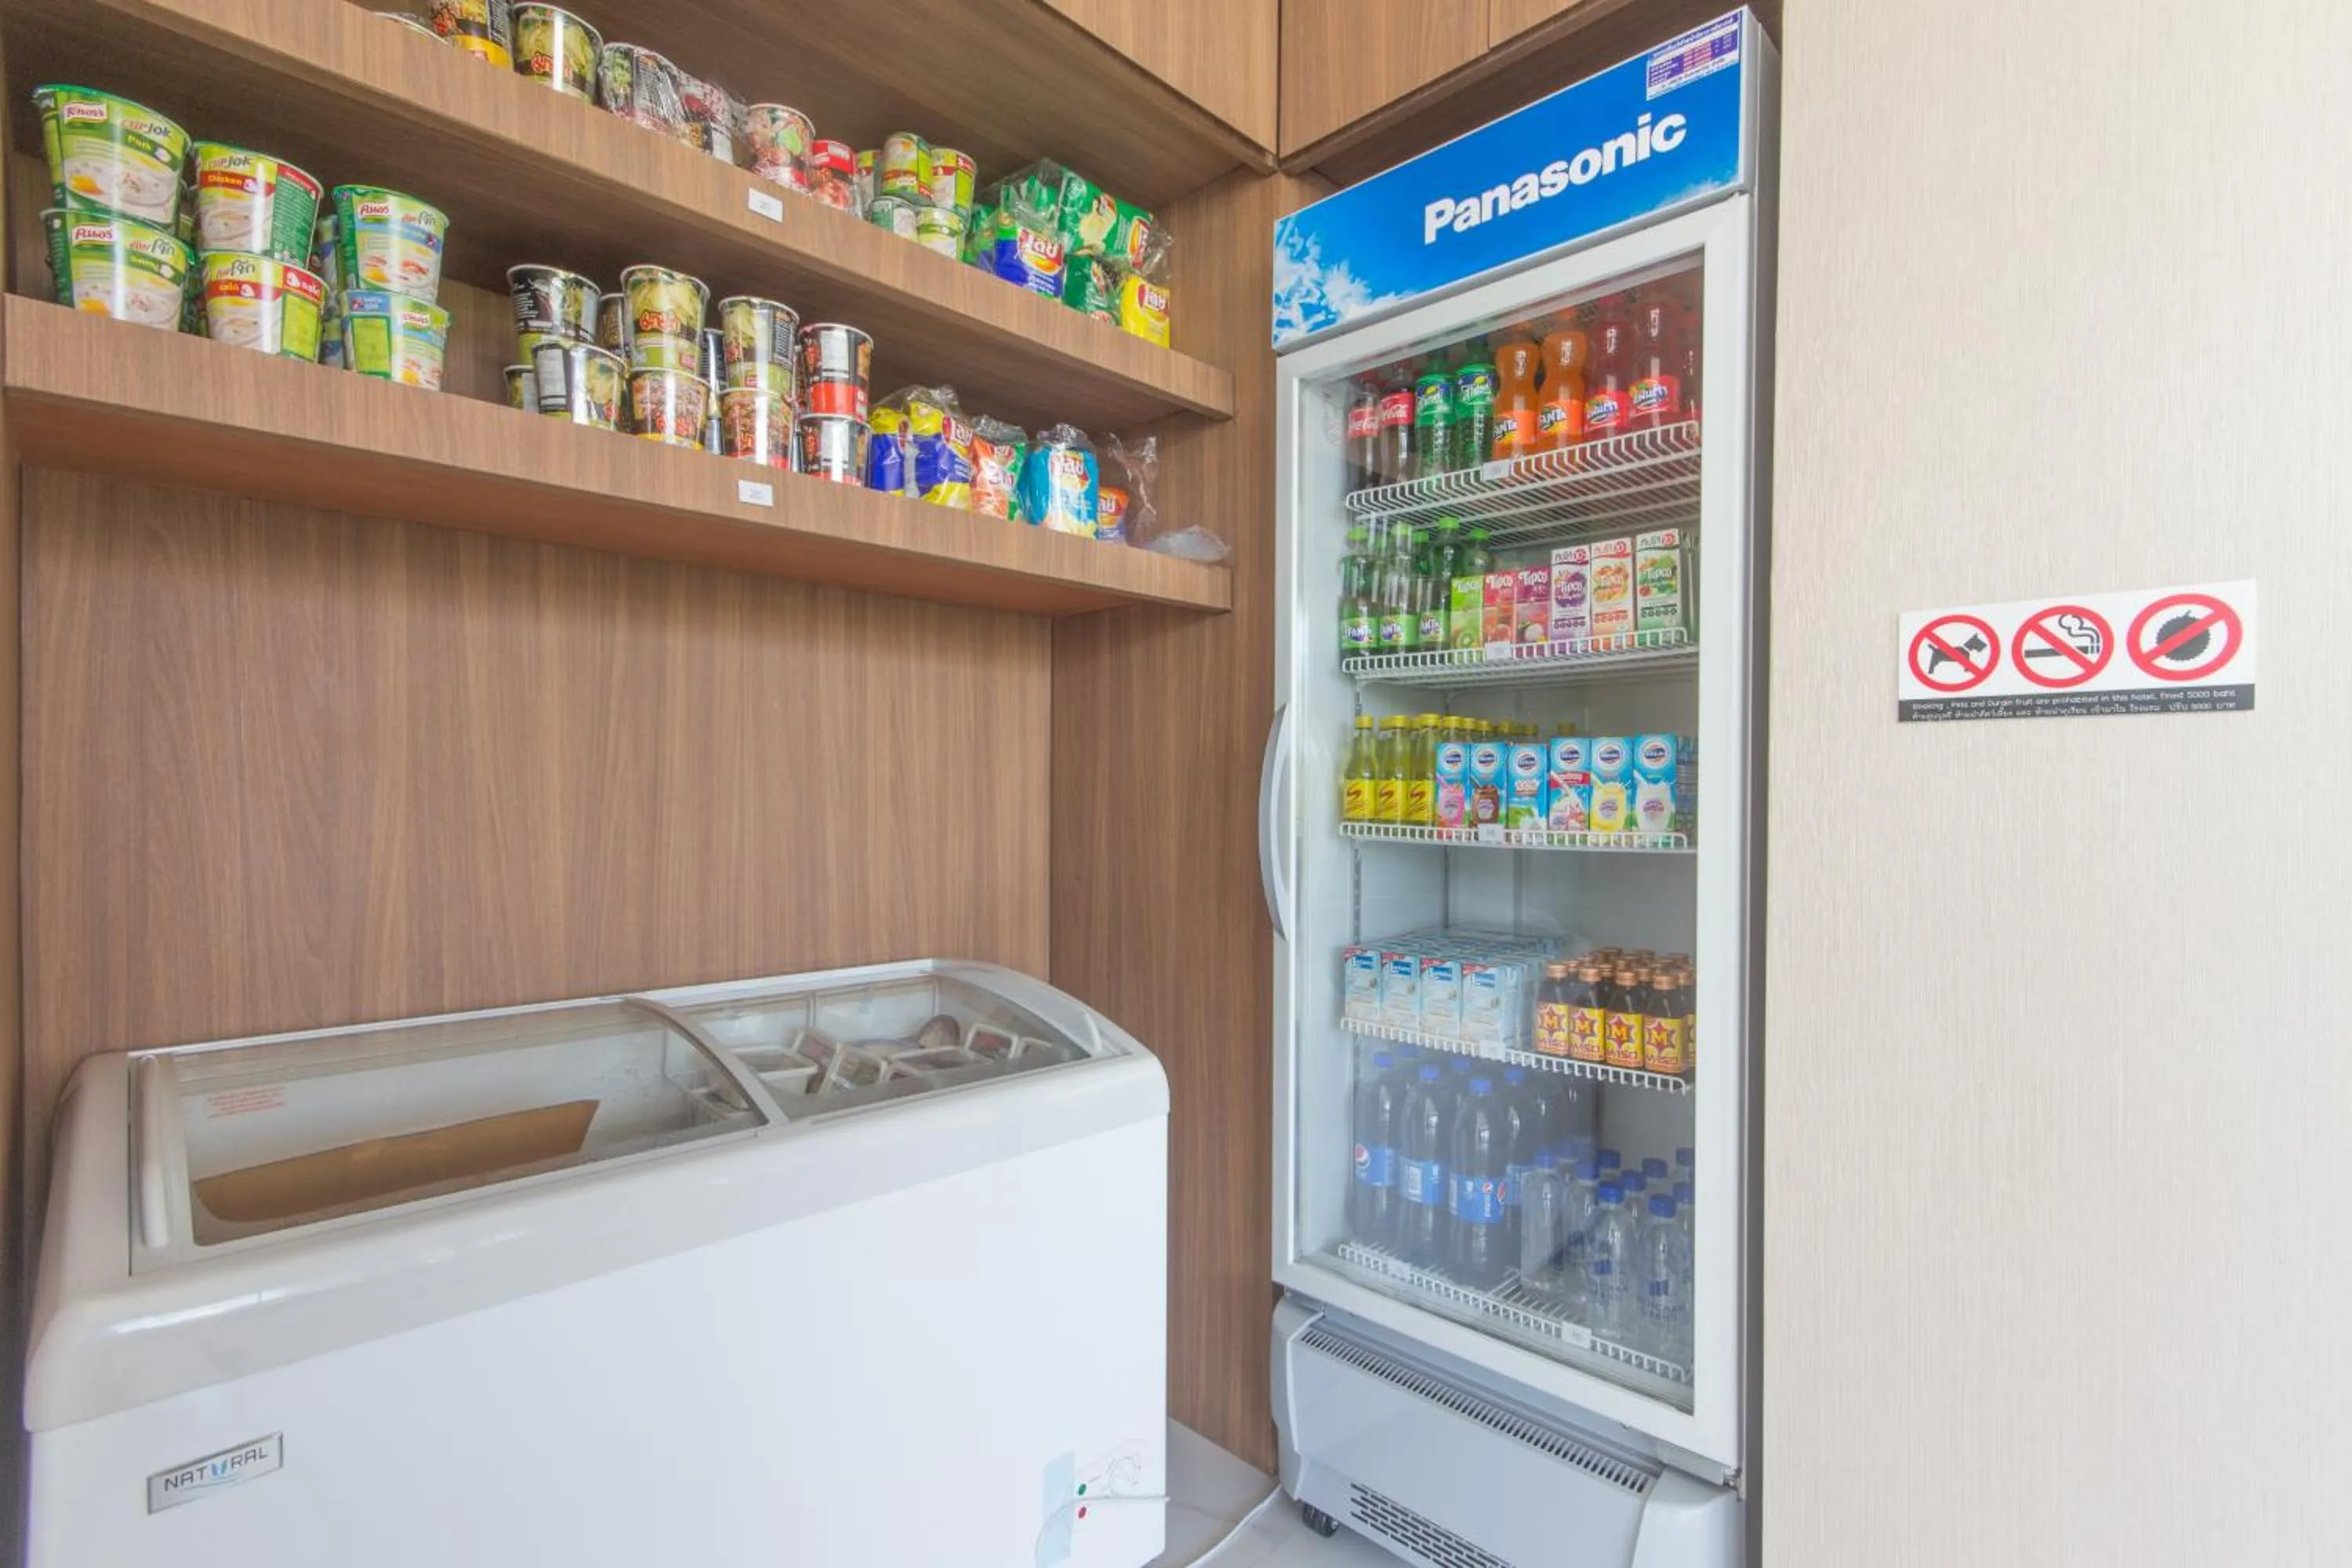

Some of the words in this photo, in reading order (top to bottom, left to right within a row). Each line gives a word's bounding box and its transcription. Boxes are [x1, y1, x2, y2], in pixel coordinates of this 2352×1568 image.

[207, 174, 243, 186] Chicken
[1424, 111, 1687, 245] Panasonic
[1518, 570, 1548, 586] Tipco
[2187, 690, 2210, 699] 5000
[1576, 1021, 1592, 1034] M
[1612, 1025, 1628, 1040] M
[1651, 1030, 1670, 1047] M
